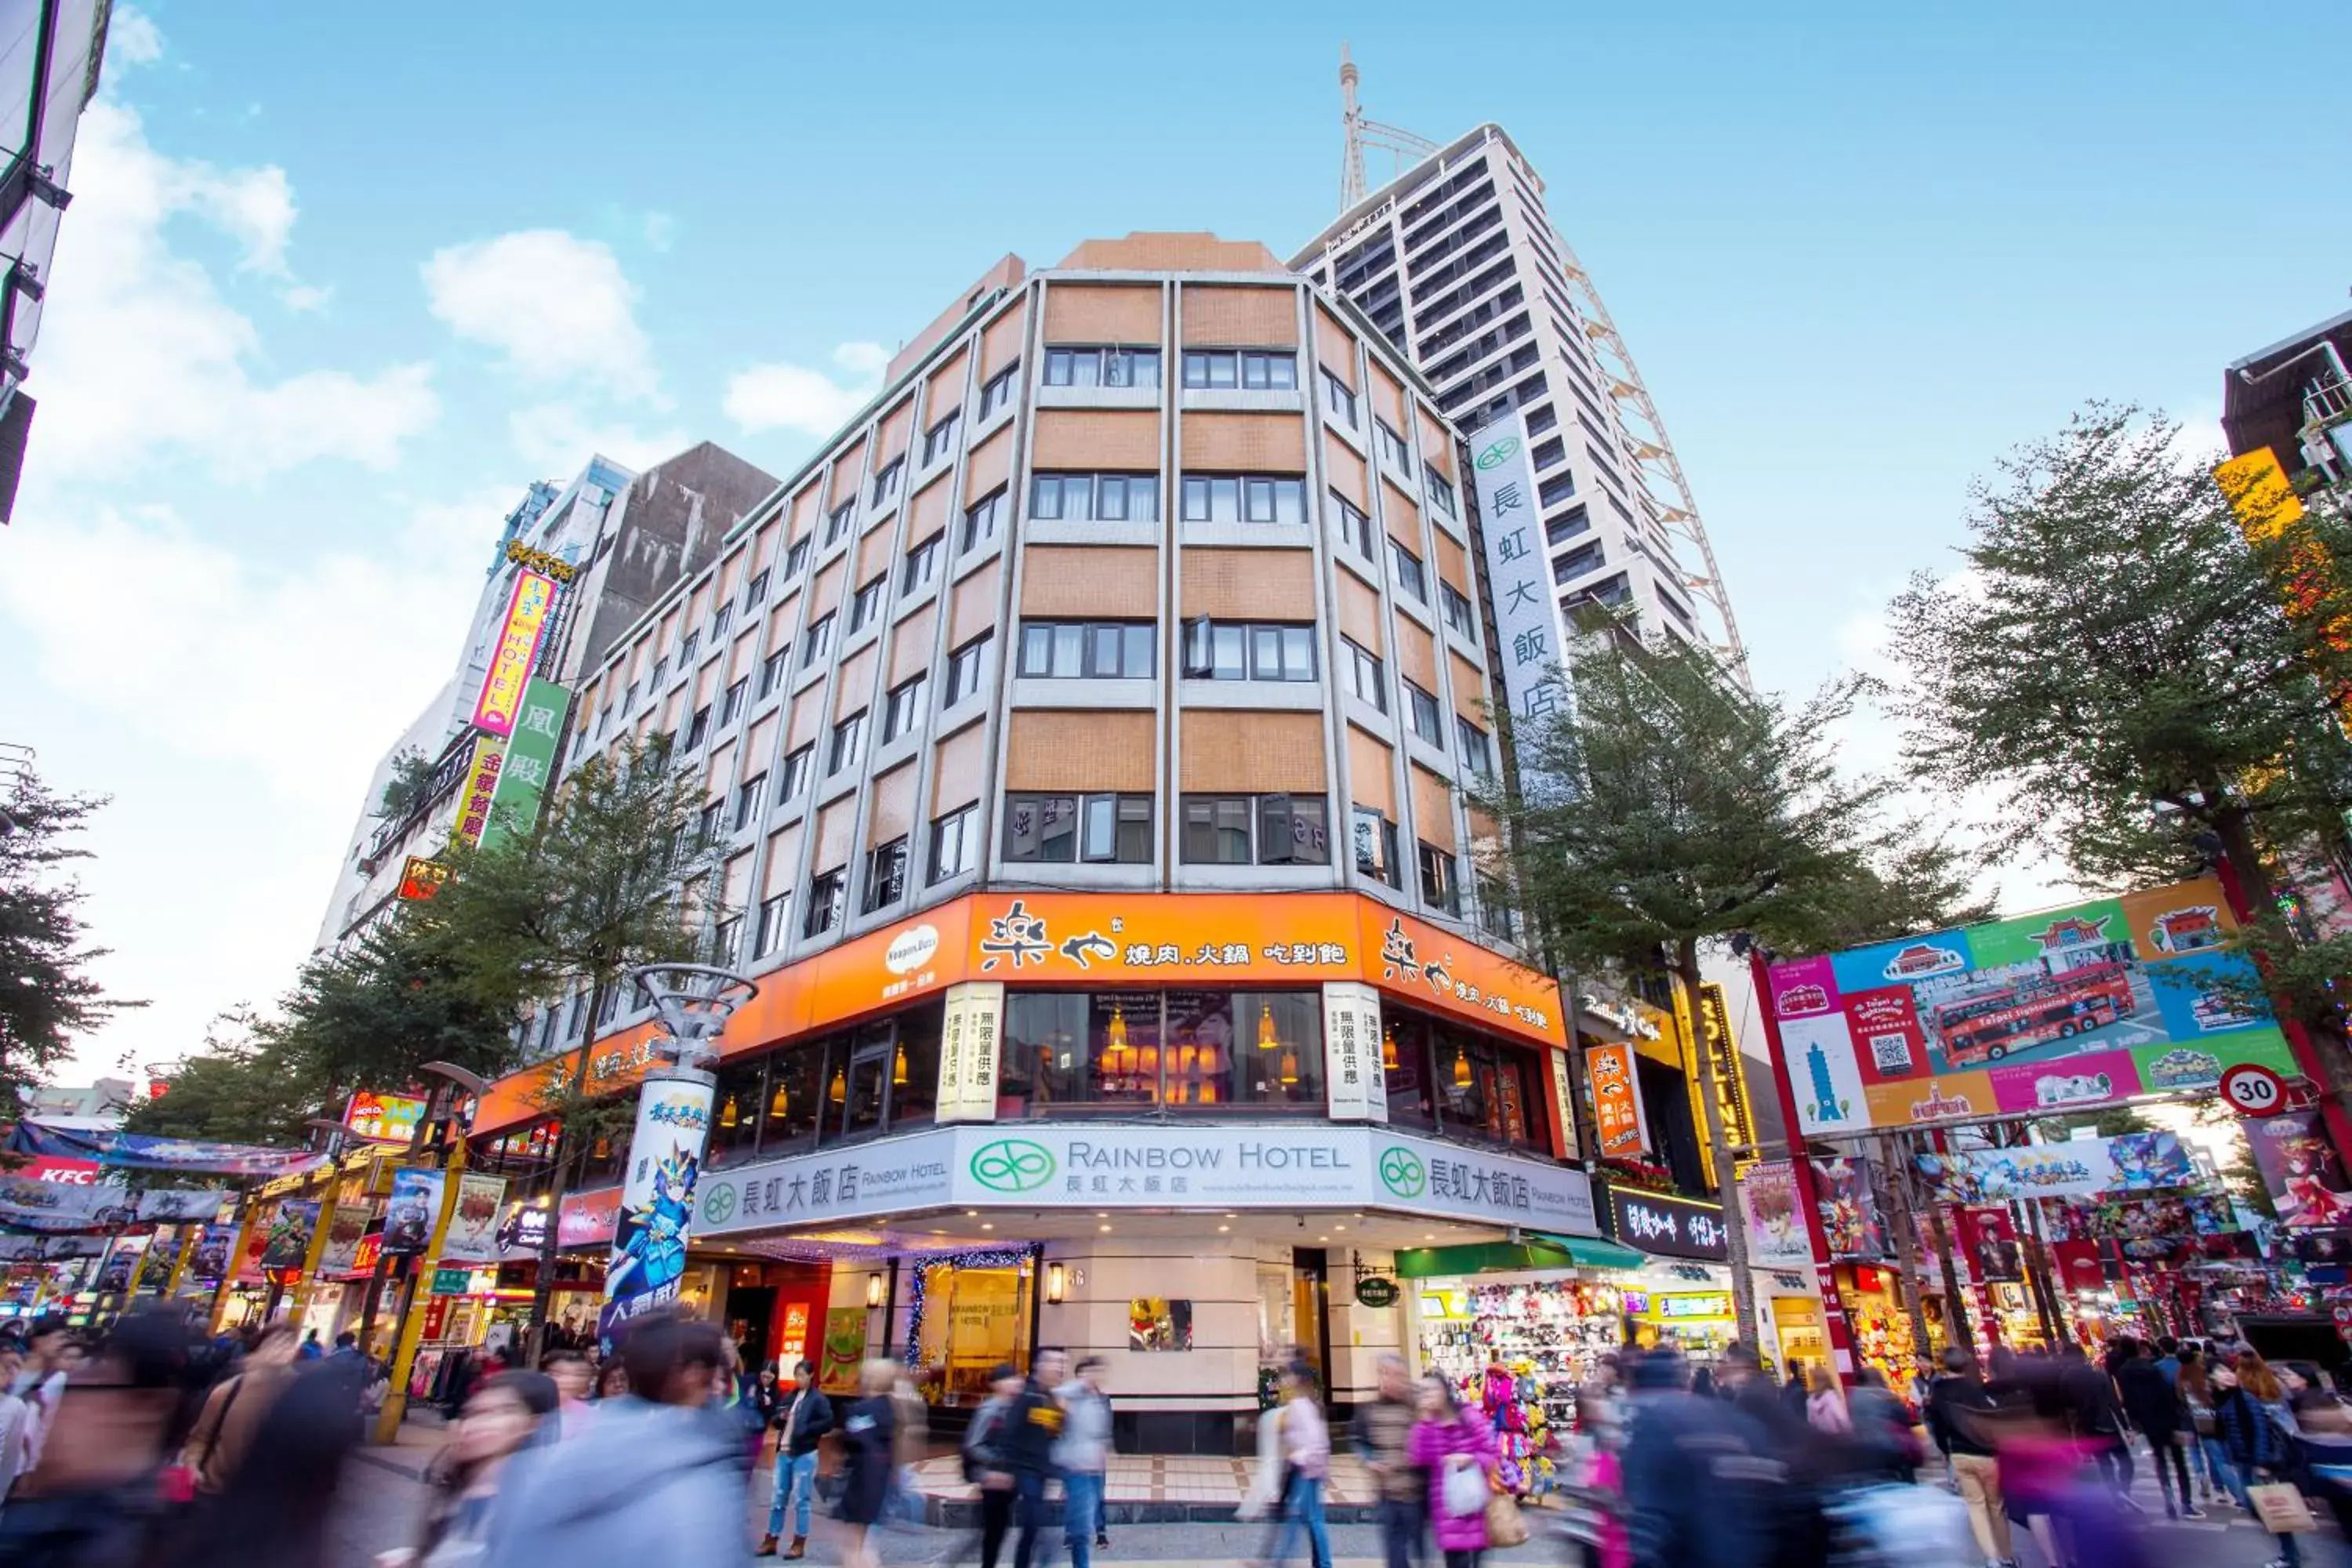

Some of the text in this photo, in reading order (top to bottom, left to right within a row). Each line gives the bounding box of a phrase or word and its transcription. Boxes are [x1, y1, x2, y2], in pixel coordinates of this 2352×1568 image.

[1491, 481, 1557, 719] 長虹大飯店
[1263, 943, 1346, 964] 吃到飽
[976, 1011, 994, 1086] 無限量供應
[1340, 1011, 1359, 1084] 無限量供應
[2235, 1080, 2272, 1102] 30
[1069, 1142, 1351, 1168] RAINBOW HOTEL
[40, 1168, 95, 1185] KFC
[742, 1163, 859, 1217] 長虹大飯店
[862, 1169, 907, 1186] RAINBOW
[911, 1162, 947, 1178] HOTEL
[1066, 1175, 1188, 1192] 長虹大飯店
[1430, 1158, 1530, 1209] 長虹大飯店
